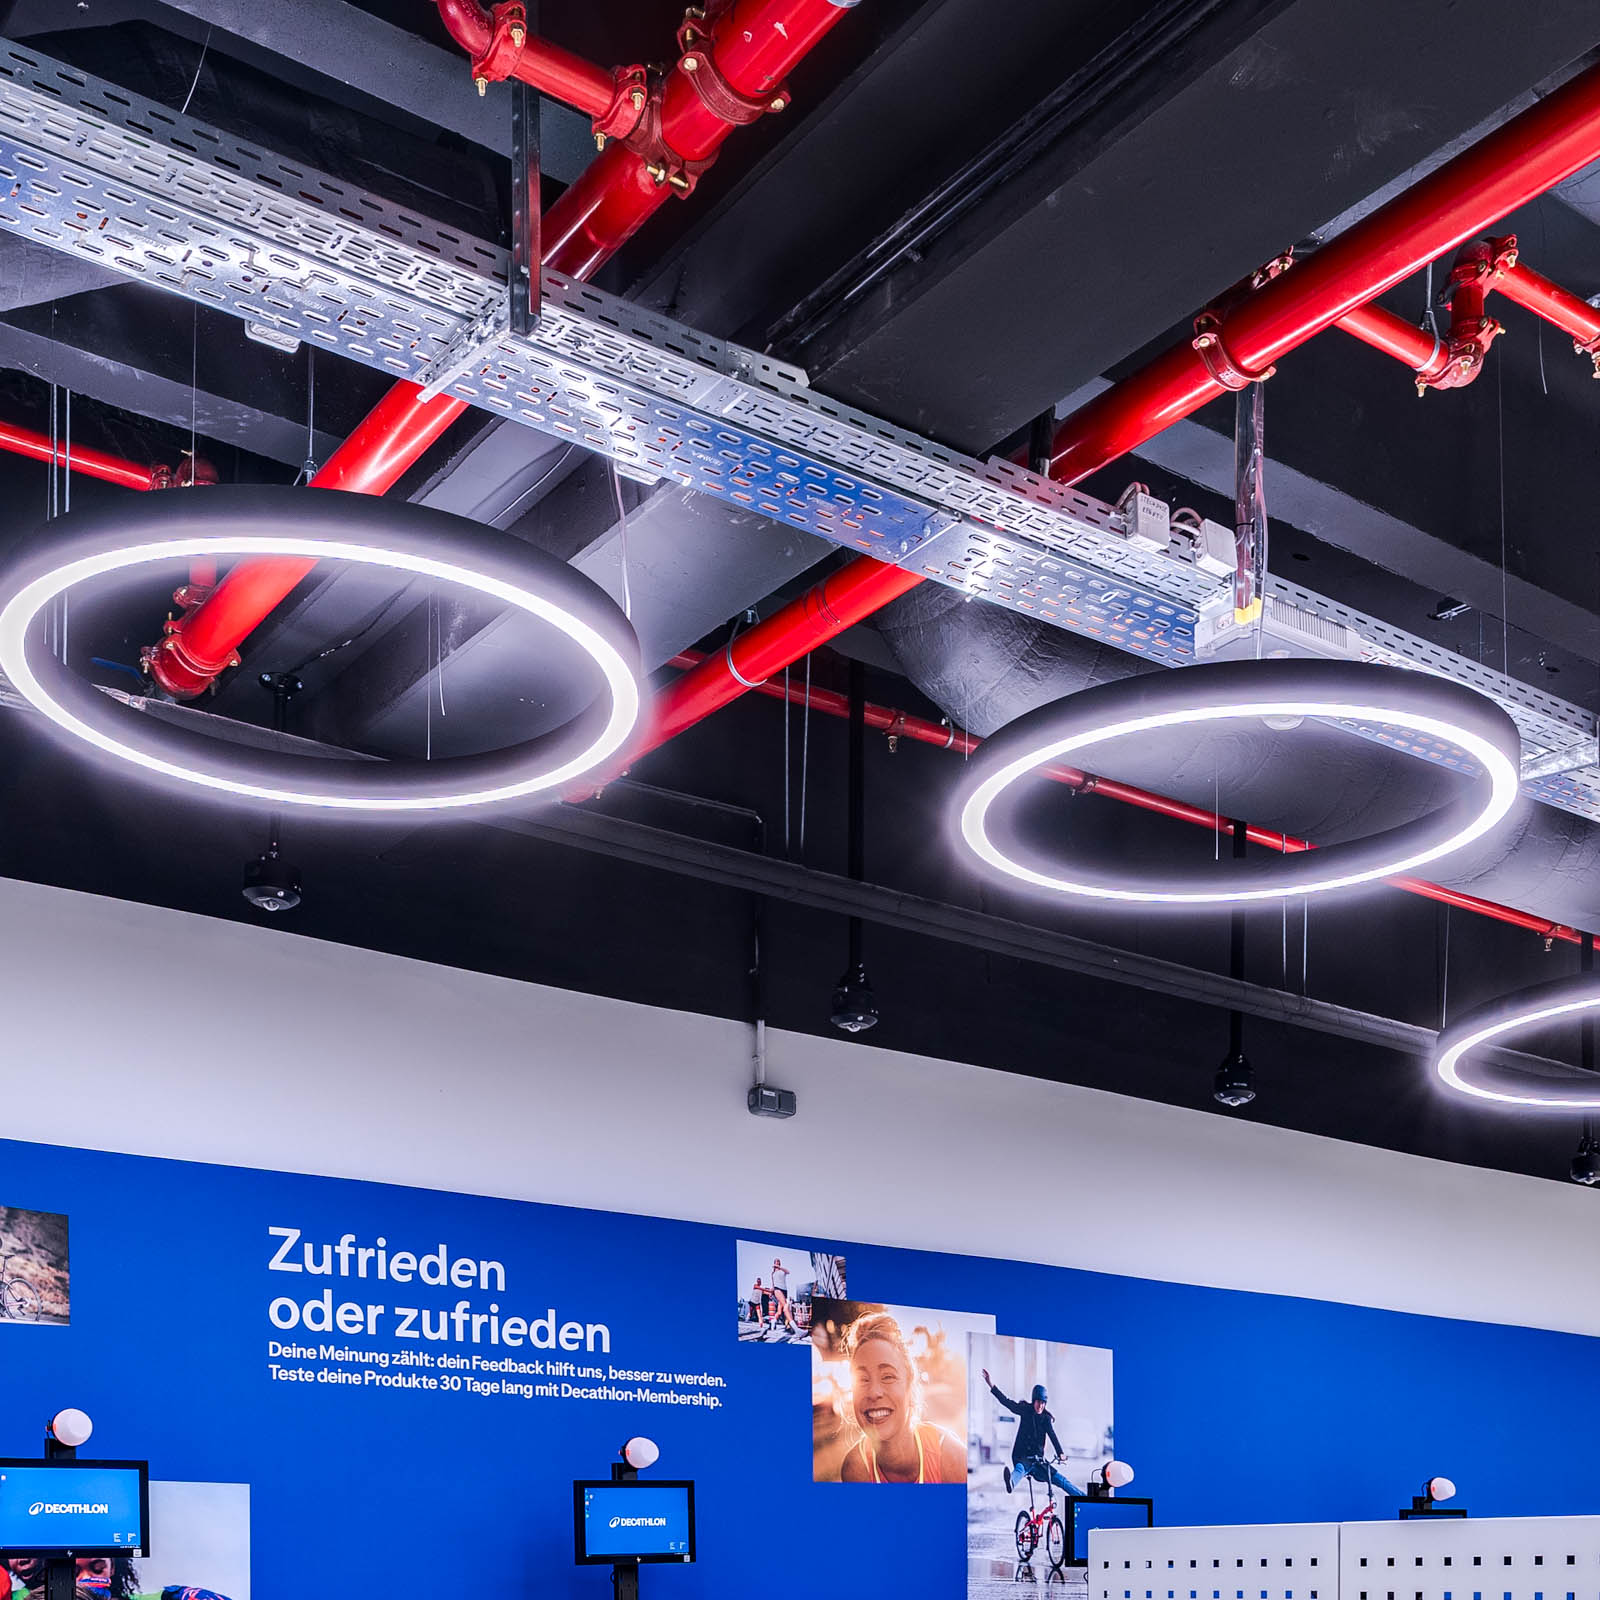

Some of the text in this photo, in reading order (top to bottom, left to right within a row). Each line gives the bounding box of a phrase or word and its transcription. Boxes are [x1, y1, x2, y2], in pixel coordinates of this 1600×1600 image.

[268, 1226, 506, 1291] Zufrieden
[268, 1289, 611, 1353] oder zufrieden
[268, 1341, 727, 1388] Deine Meinung zählt: dein Feedback hilft uns, besser zu werden.
[269, 1364, 722, 1409] Teste deine Produkte 30 Tage lang mit Decathlon-Membership.
[45, 1504, 108, 1514] DECATHLON
[620, 1517, 666, 1526] DECATHLON
